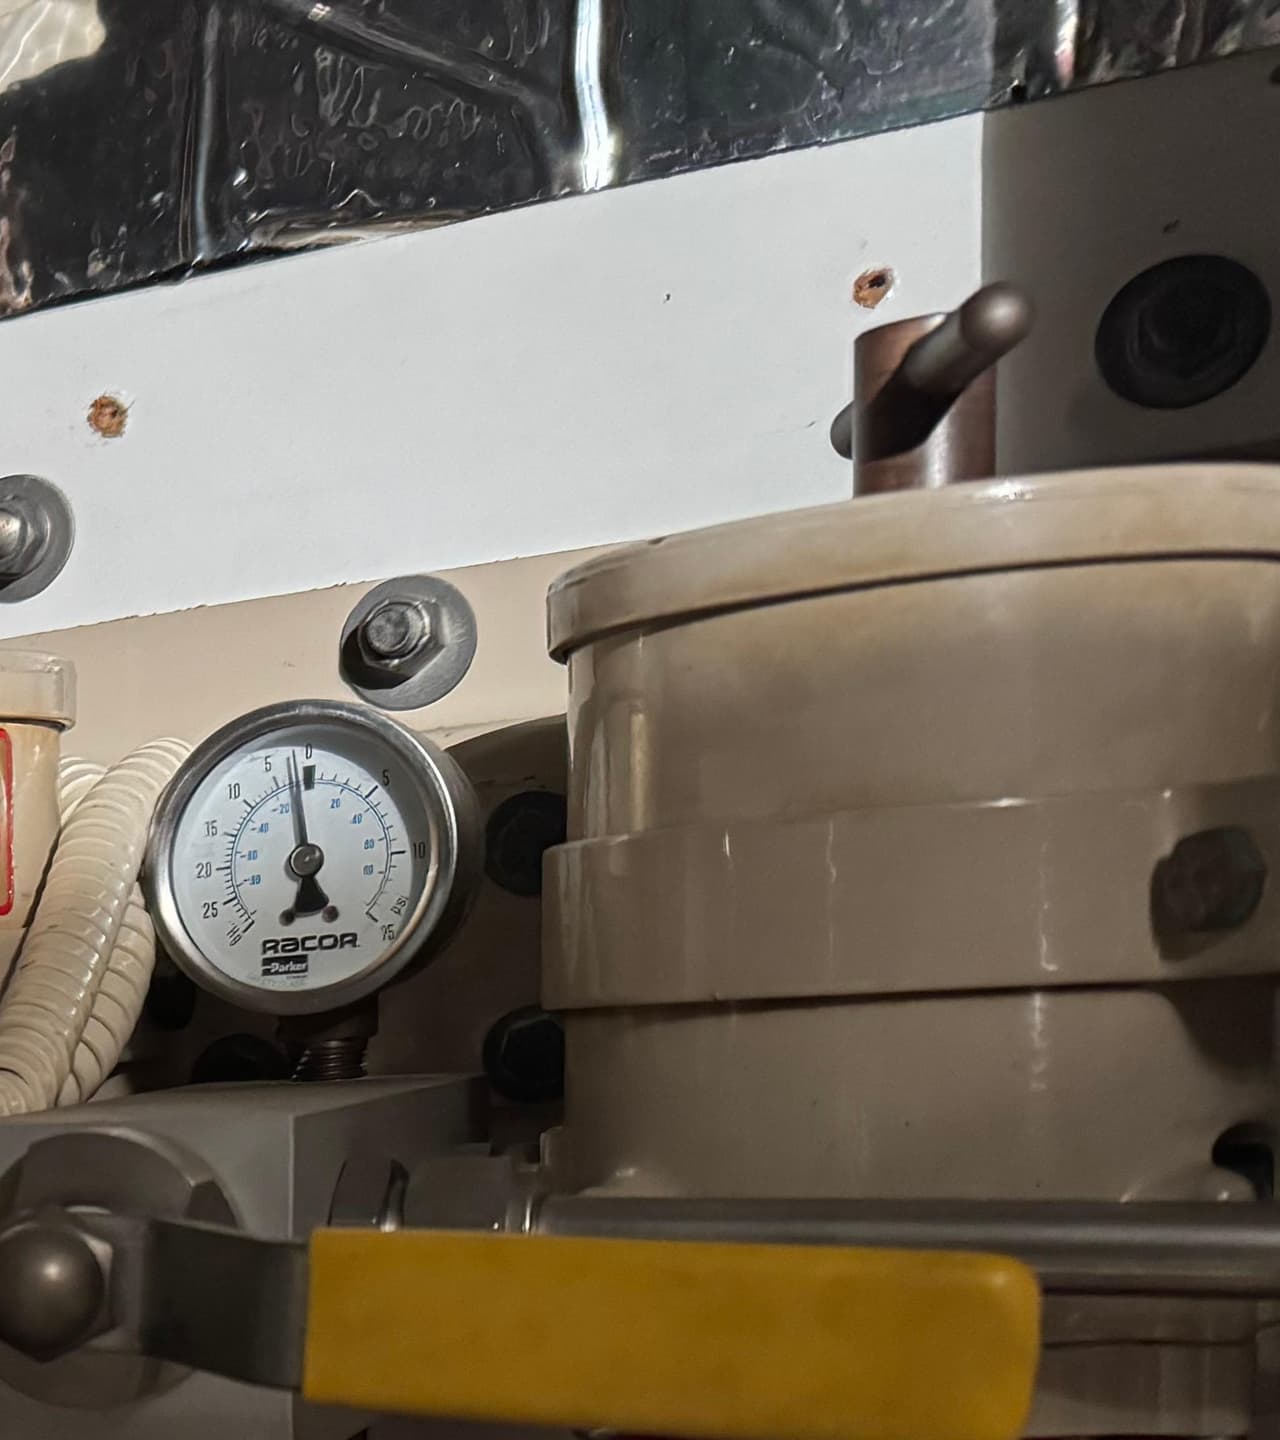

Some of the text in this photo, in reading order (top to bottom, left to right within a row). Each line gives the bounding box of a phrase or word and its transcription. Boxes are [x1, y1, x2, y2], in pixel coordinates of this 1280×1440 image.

[305, 744, 313, 759] 0
[264, 756, 272, 772] 5
[382, 769, 390, 786] 5
[228, 783, 241, 799] 10
[413, 842, 425, 859] 10
[196, 862, 212, 879] 20
[203, 901, 218, 918] 25
